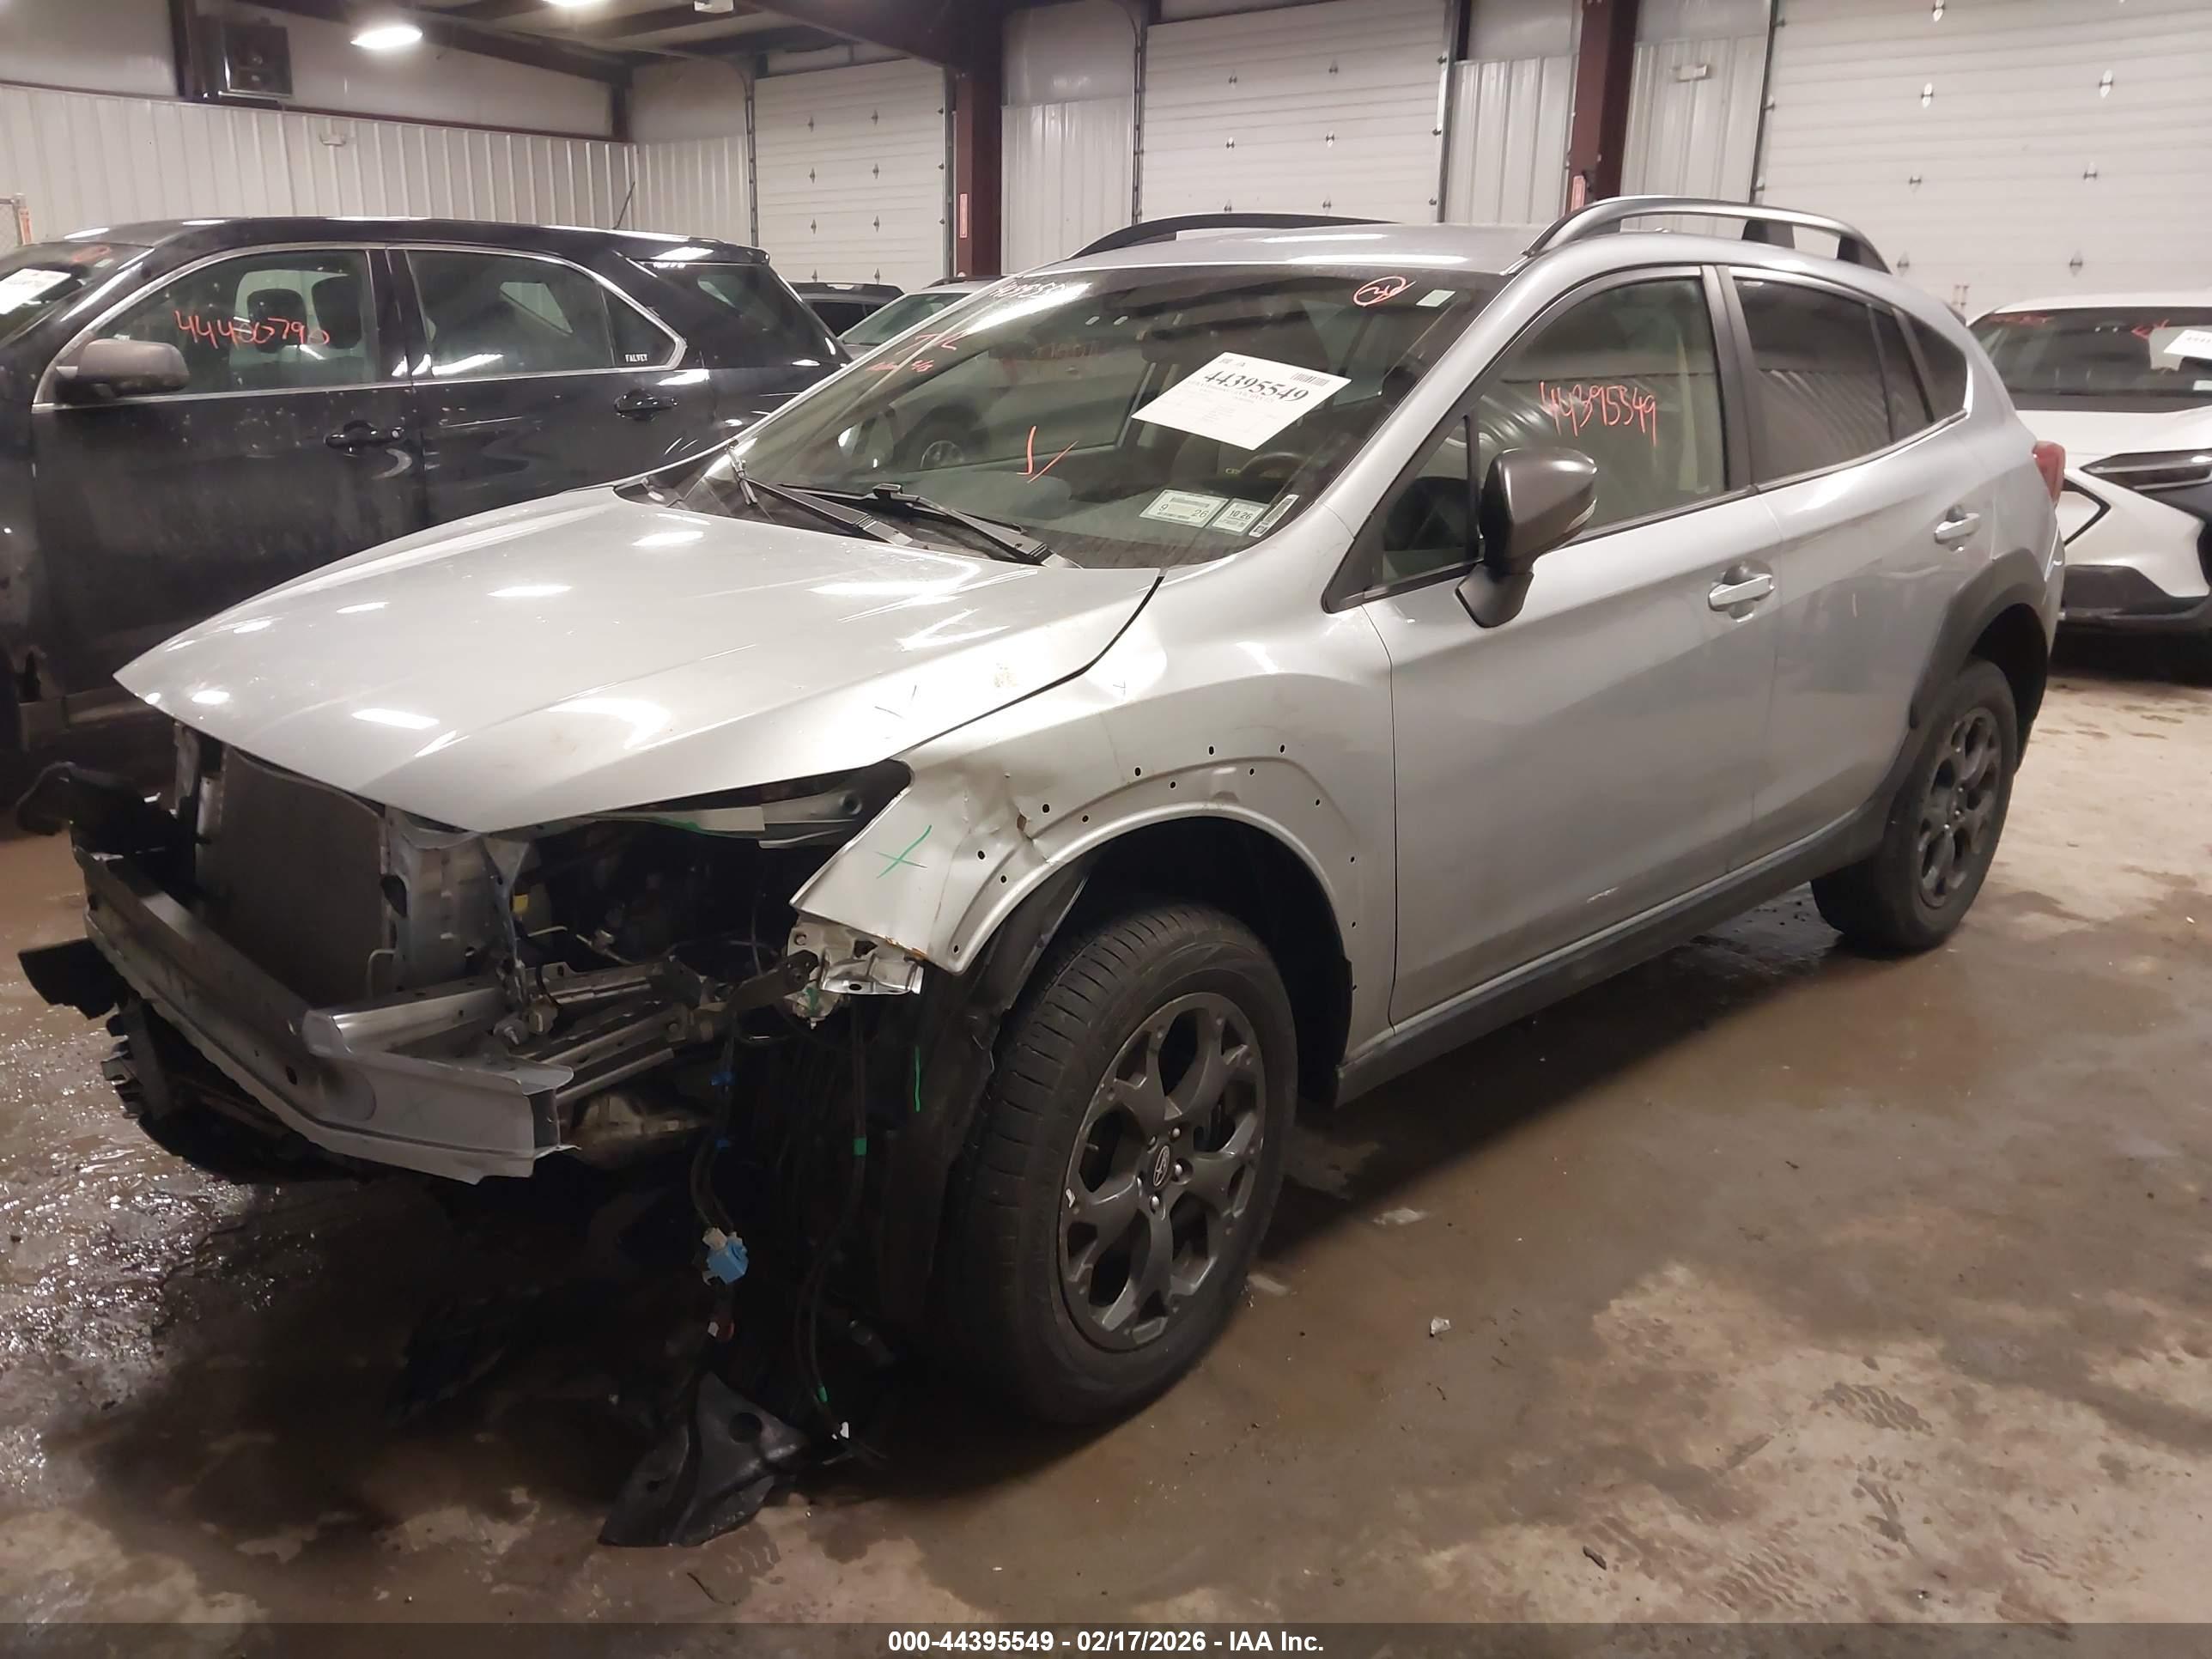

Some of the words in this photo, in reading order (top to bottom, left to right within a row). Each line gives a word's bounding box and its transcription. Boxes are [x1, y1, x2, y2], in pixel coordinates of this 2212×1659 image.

[1204, 370, 1310, 402] 44395549
[1540, 381, 1656, 447] 44395549
[1190, 509, 1208, 519] 26
[1240, 512, 1253, 520] 26
